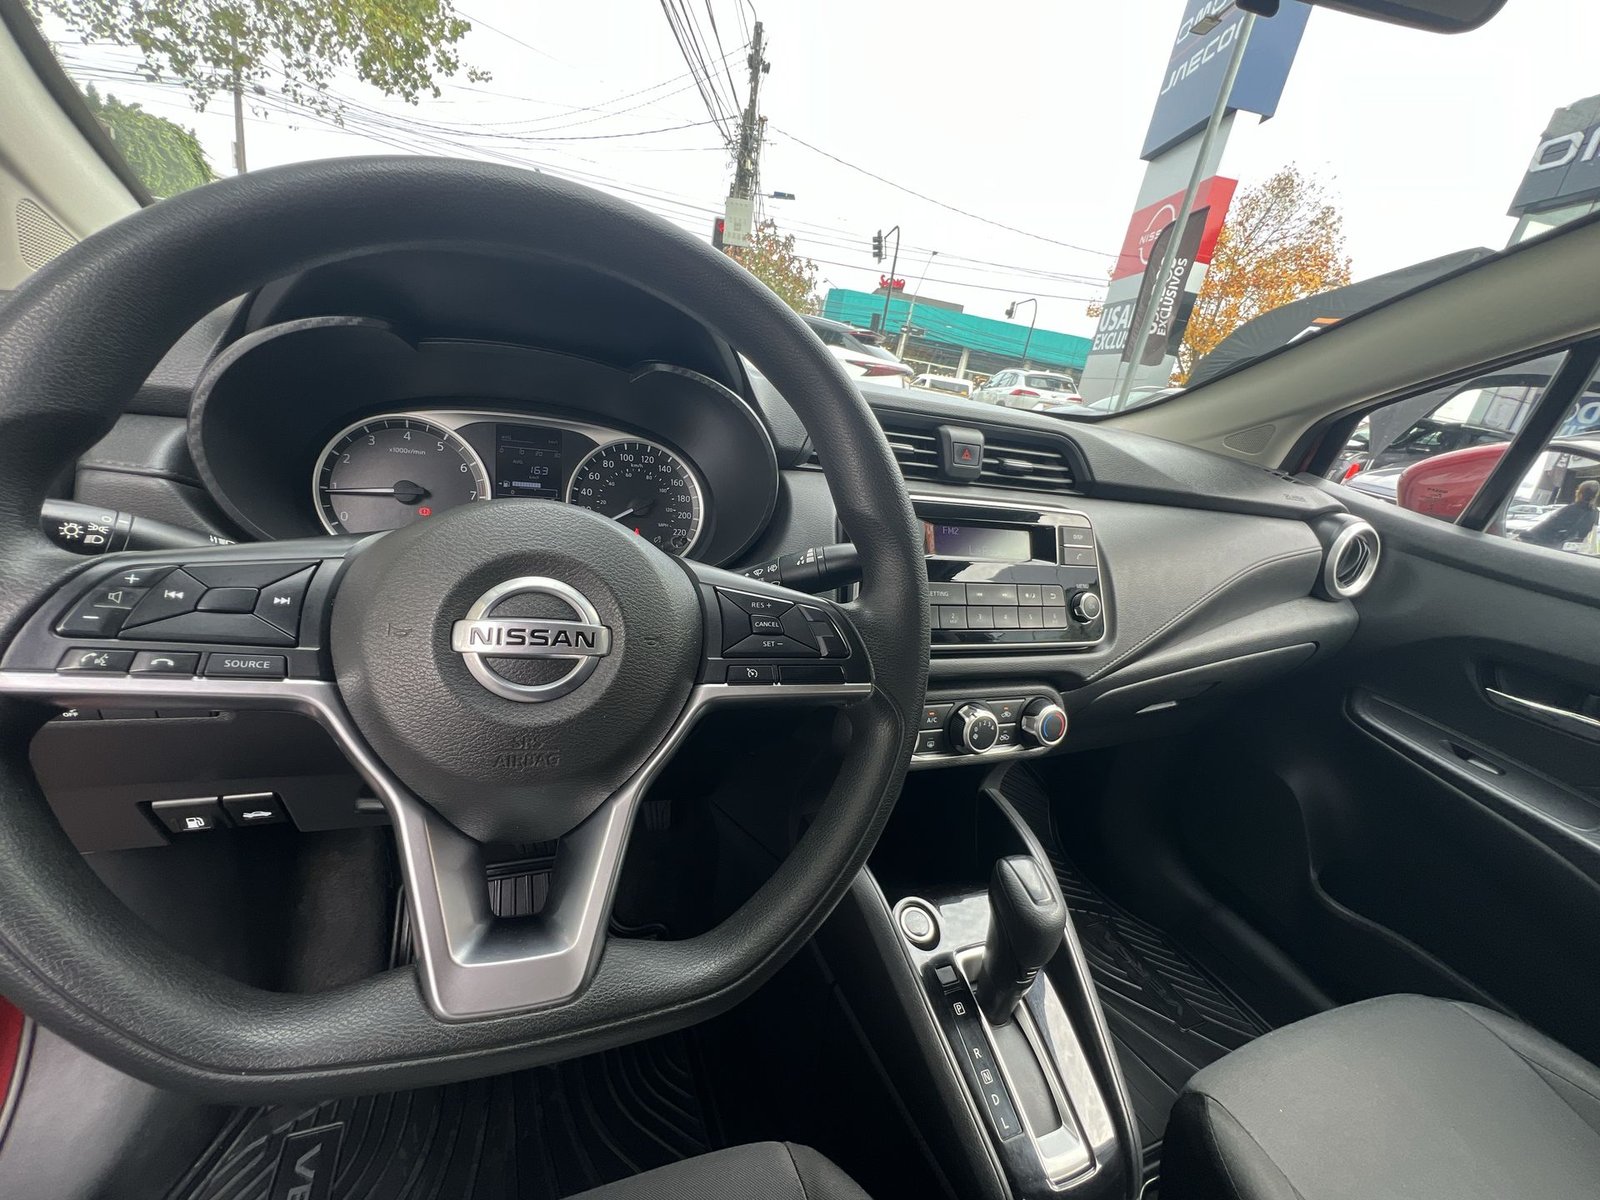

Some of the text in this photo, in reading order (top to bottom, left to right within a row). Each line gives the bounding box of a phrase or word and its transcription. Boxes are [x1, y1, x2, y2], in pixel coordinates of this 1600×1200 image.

[1157, 257, 1188, 336] EXCLUSIVOS
[368, 435, 376, 446] 3
[403, 431, 411, 441] 4
[437, 441, 445, 452] 5
[343, 453, 350, 464] 2
[620, 453, 634, 462] 100
[641, 455, 655, 464] 120
[460, 464, 468, 473] 6
[602, 460, 615, 468] 80
[658, 464, 672, 473] 140
[588, 472, 600, 480] 60
[670, 479, 684, 487] 160
[470, 491, 477, 500] 7
[580, 488, 593, 496] 40
[677, 494, 691, 503] 180
[340, 511, 349, 521] 0
[678, 511, 692, 519] 200
[673, 528, 687, 536] 220
[469, 627, 596, 649] NISSAN
[224, 659, 270, 670] SOURCE
[973, 1048, 981, 1058] R
[991, 1094, 1000, 1106] D
[1001, 1118, 1009, 1130] L
